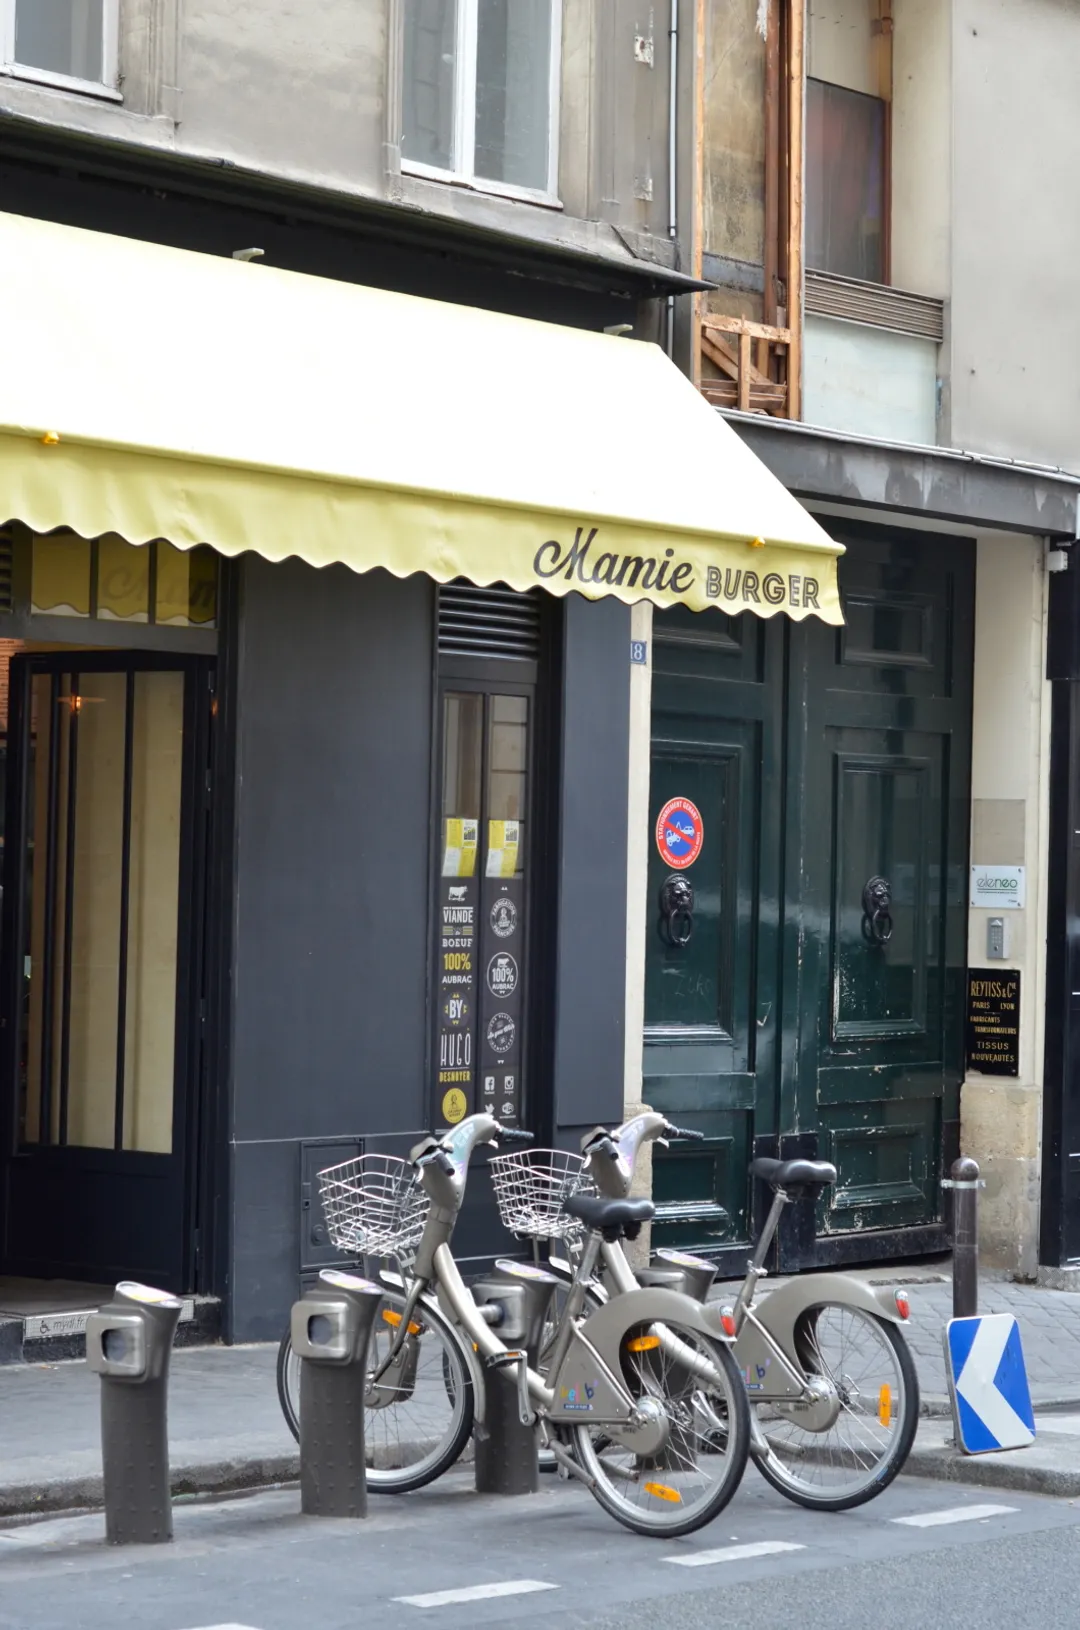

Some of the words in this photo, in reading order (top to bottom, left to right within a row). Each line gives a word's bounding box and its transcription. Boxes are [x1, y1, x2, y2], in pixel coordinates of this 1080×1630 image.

[532, 526, 695, 593] Mamie
[705, 565, 821, 610] BURGER
[976, 872, 1018, 889] eleneo
[443, 909, 474, 924] VIANDE
[442, 938, 473, 948] BOEUF
[443, 952, 471, 971] 100%
[441, 975, 472, 984] AUBRAC
[492, 967, 514, 983] 100%
[970, 980, 1002, 998] REYTISS
[449, 999, 463, 1019] BY
[972, 1001, 991, 1009] PARIS
[1000, 1002, 1015, 1010] LYON
[969, 1015, 1001, 1024] FABRICANTS
[440, 1033, 471, 1067] HUGO
[976, 1041, 1009, 1050] TISSUS
